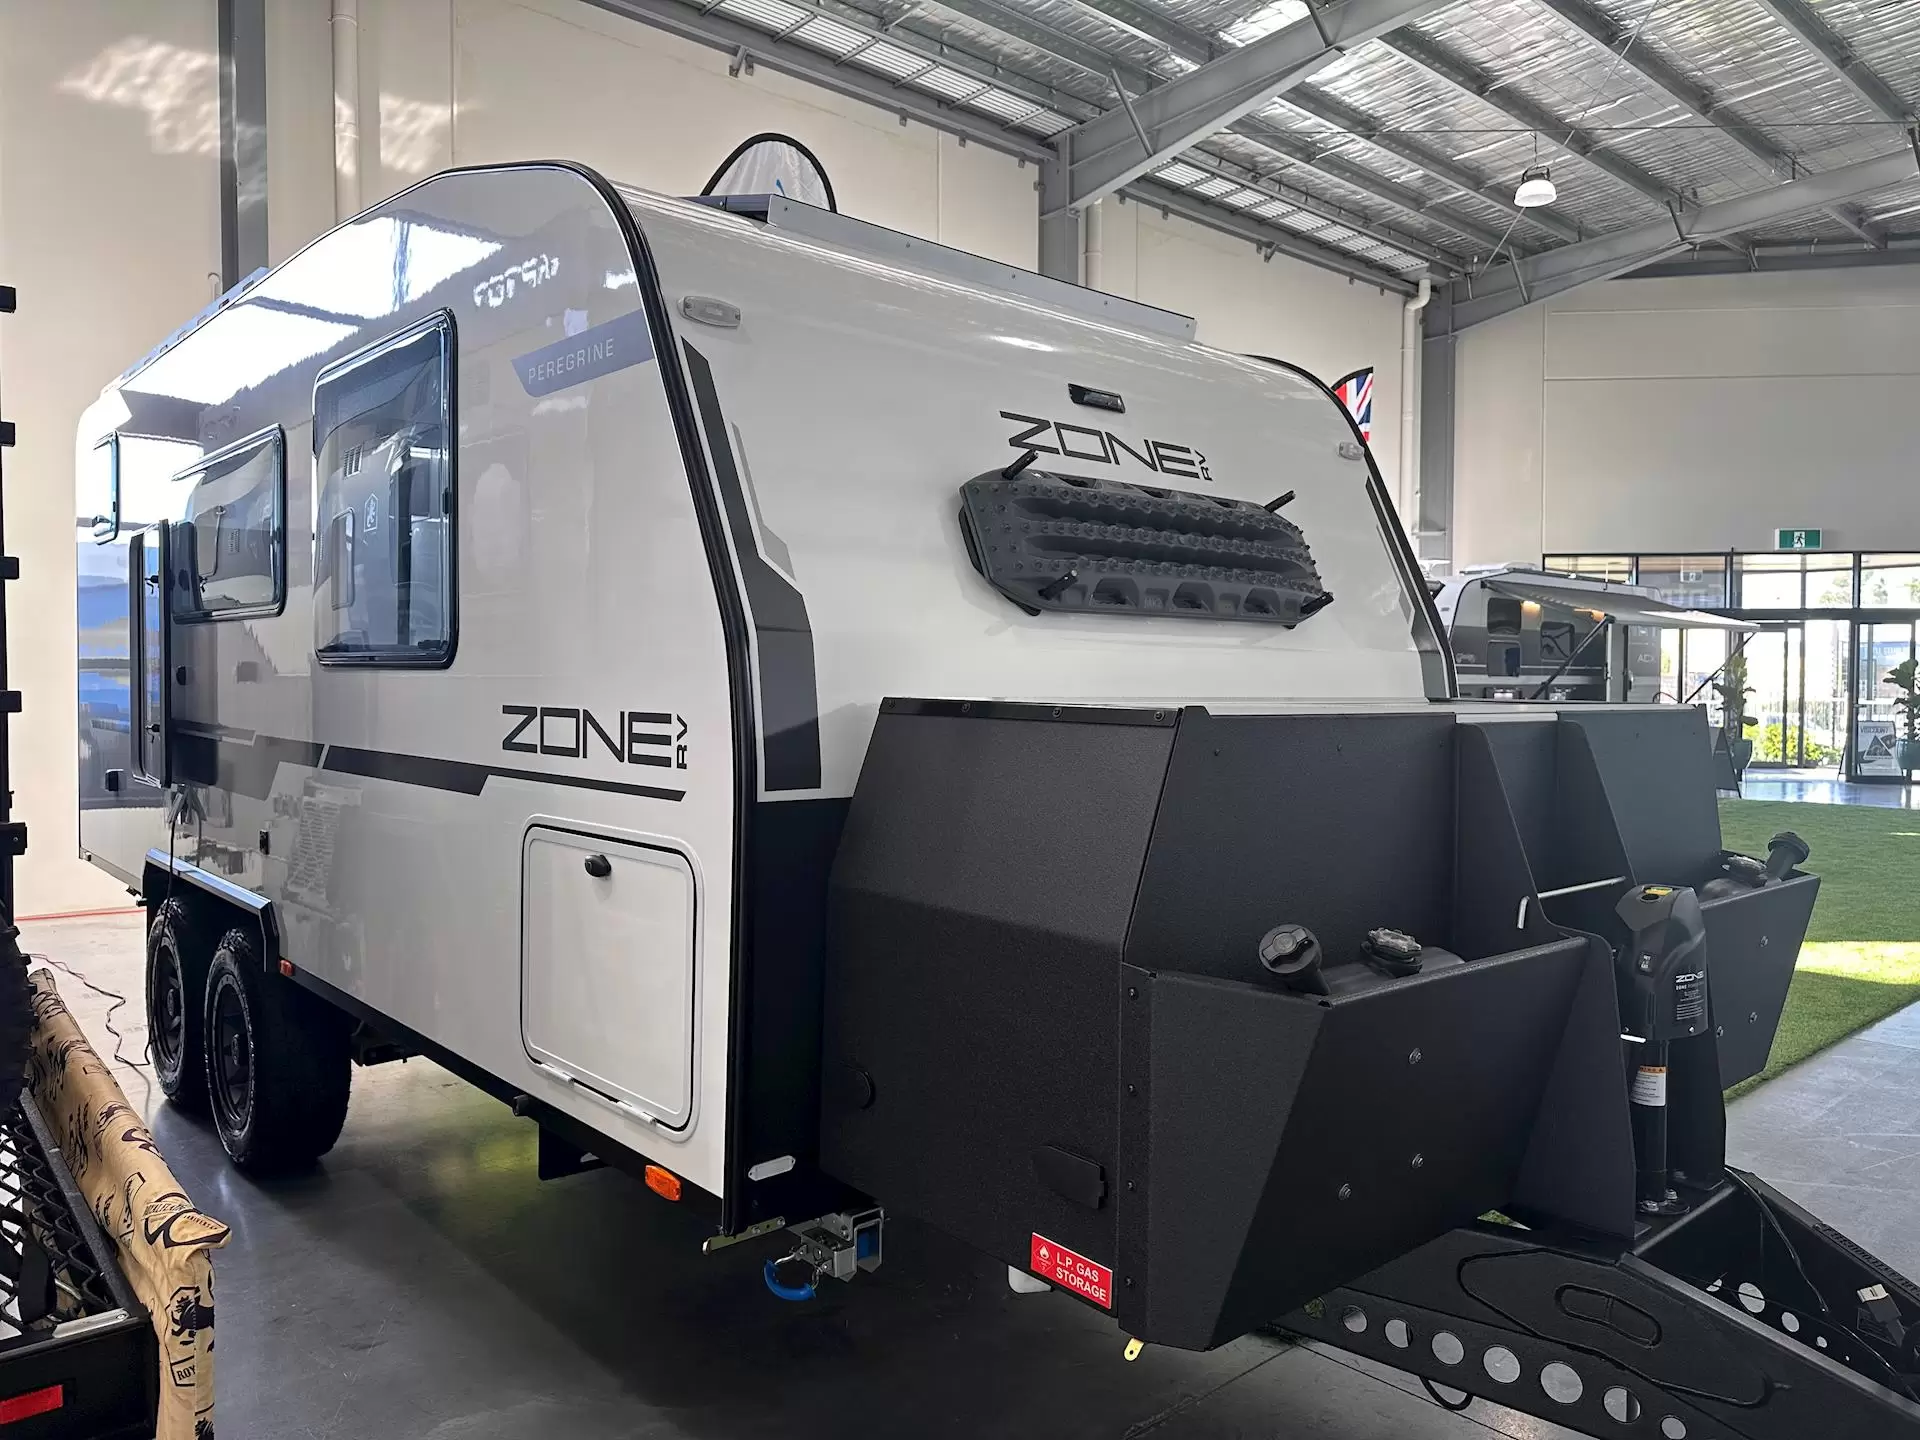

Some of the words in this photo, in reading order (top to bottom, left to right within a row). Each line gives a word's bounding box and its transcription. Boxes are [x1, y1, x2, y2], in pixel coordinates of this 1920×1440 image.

[528, 338, 615, 384] PEREGRINE
[999, 410, 1201, 479] ZONE
[1195, 450, 1213, 481] RV
[502, 704, 673, 768] ZONE
[676, 713, 688, 769] RV
[1056, 1266, 1107, 1302] STORAGE
[1076, 1262, 1099, 1283] GAS
